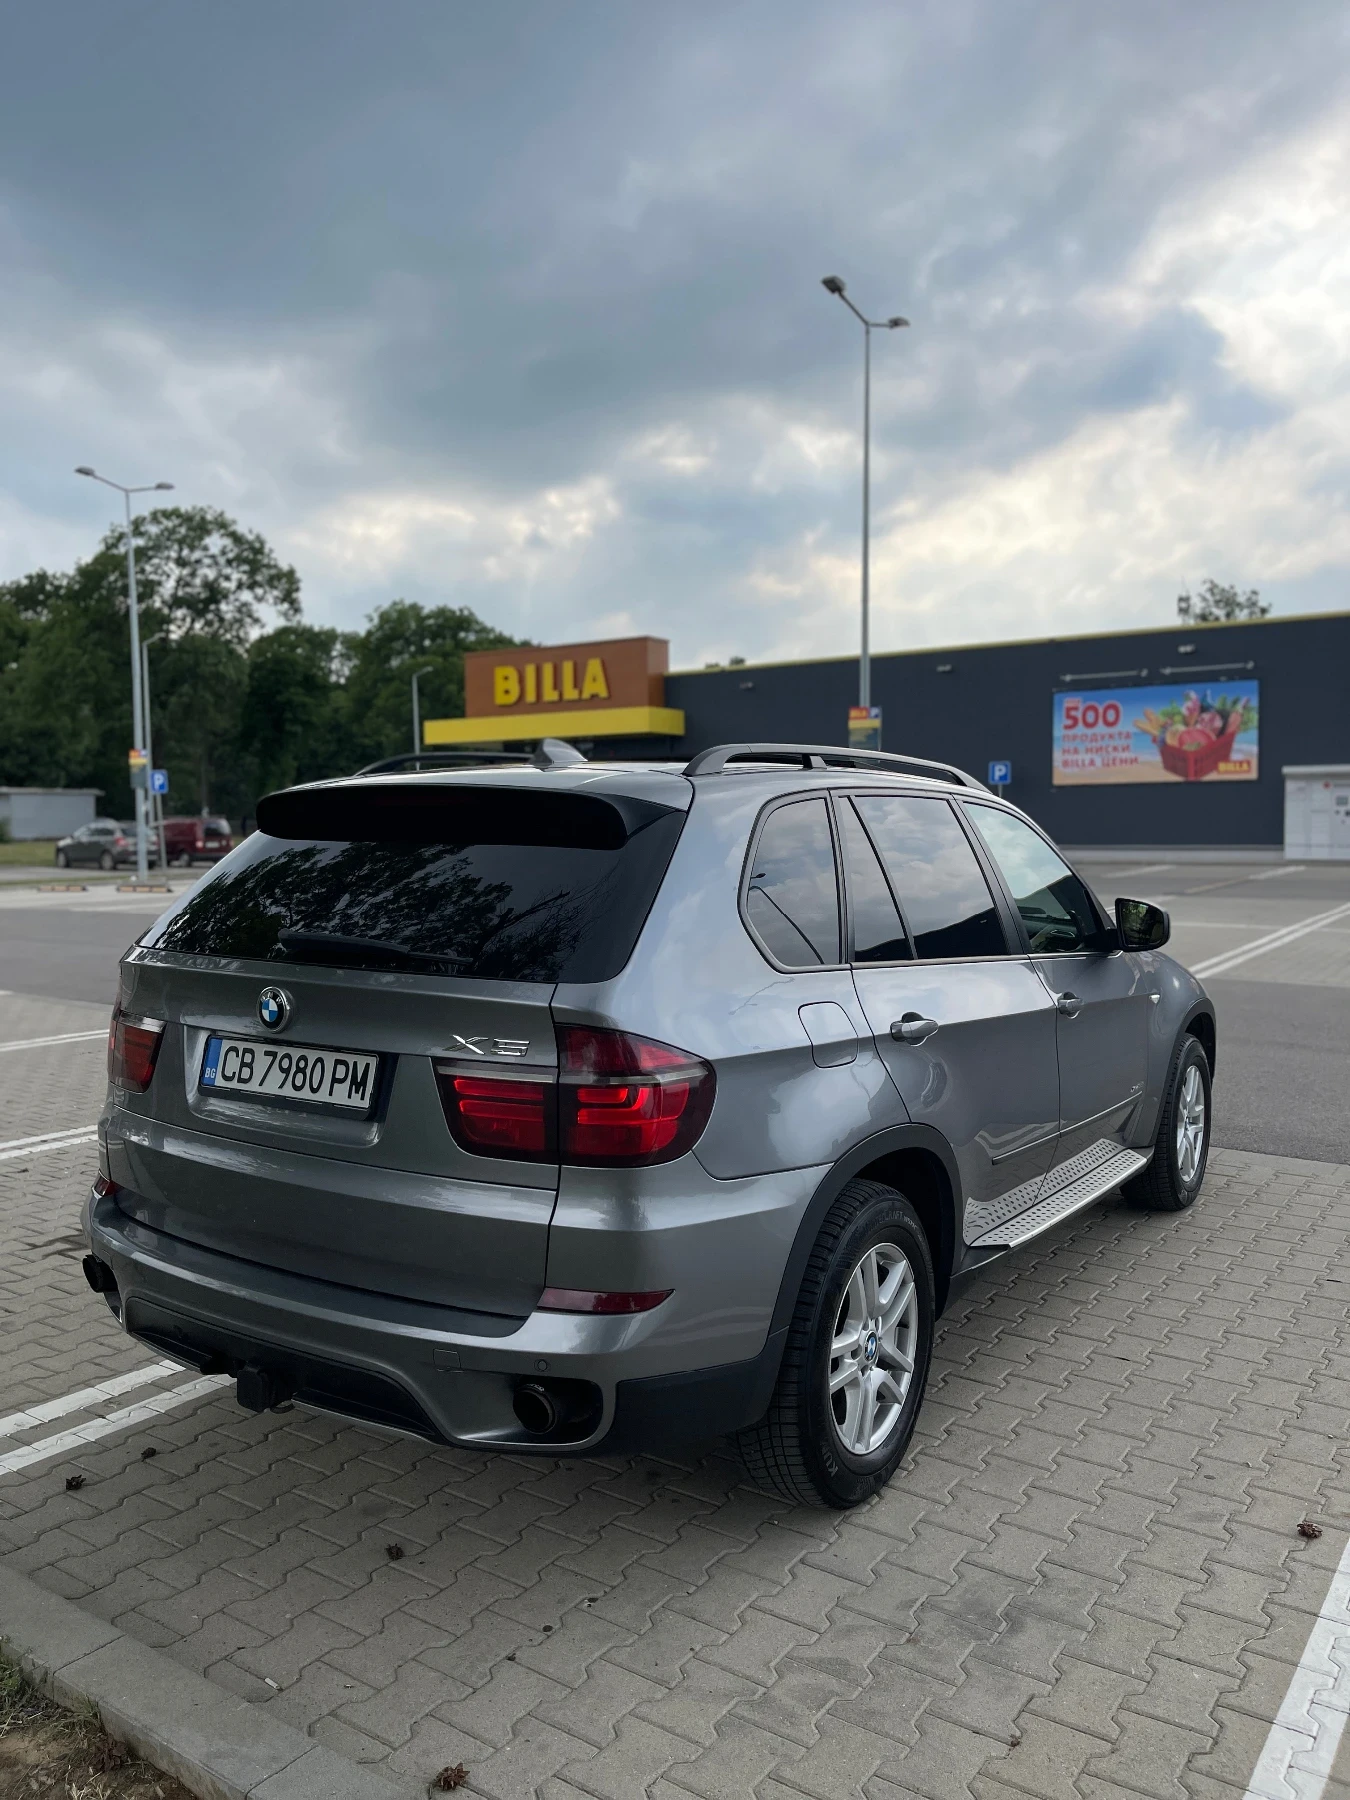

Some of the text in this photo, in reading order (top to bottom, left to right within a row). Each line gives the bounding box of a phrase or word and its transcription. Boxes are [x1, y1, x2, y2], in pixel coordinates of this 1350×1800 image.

[494, 657, 610, 706] BILLA
[1063, 704, 1120, 729] 500
[1062, 731, 1132, 743] ПРОДУКТА
[1062, 744, 1131, 755] НА НИСКИ
[1062, 756, 1139, 768] BILLA ЦЕНИ
[1218, 762, 1249, 772] BILLA
[994, 765, 1005, 781] P
[154, 773, 165, 791] P
[444, 1034, 531, 1056] X5
[204, 1066, 216, 1079] BG
[221, 1045, 370, 1100] CB 7980 PM
